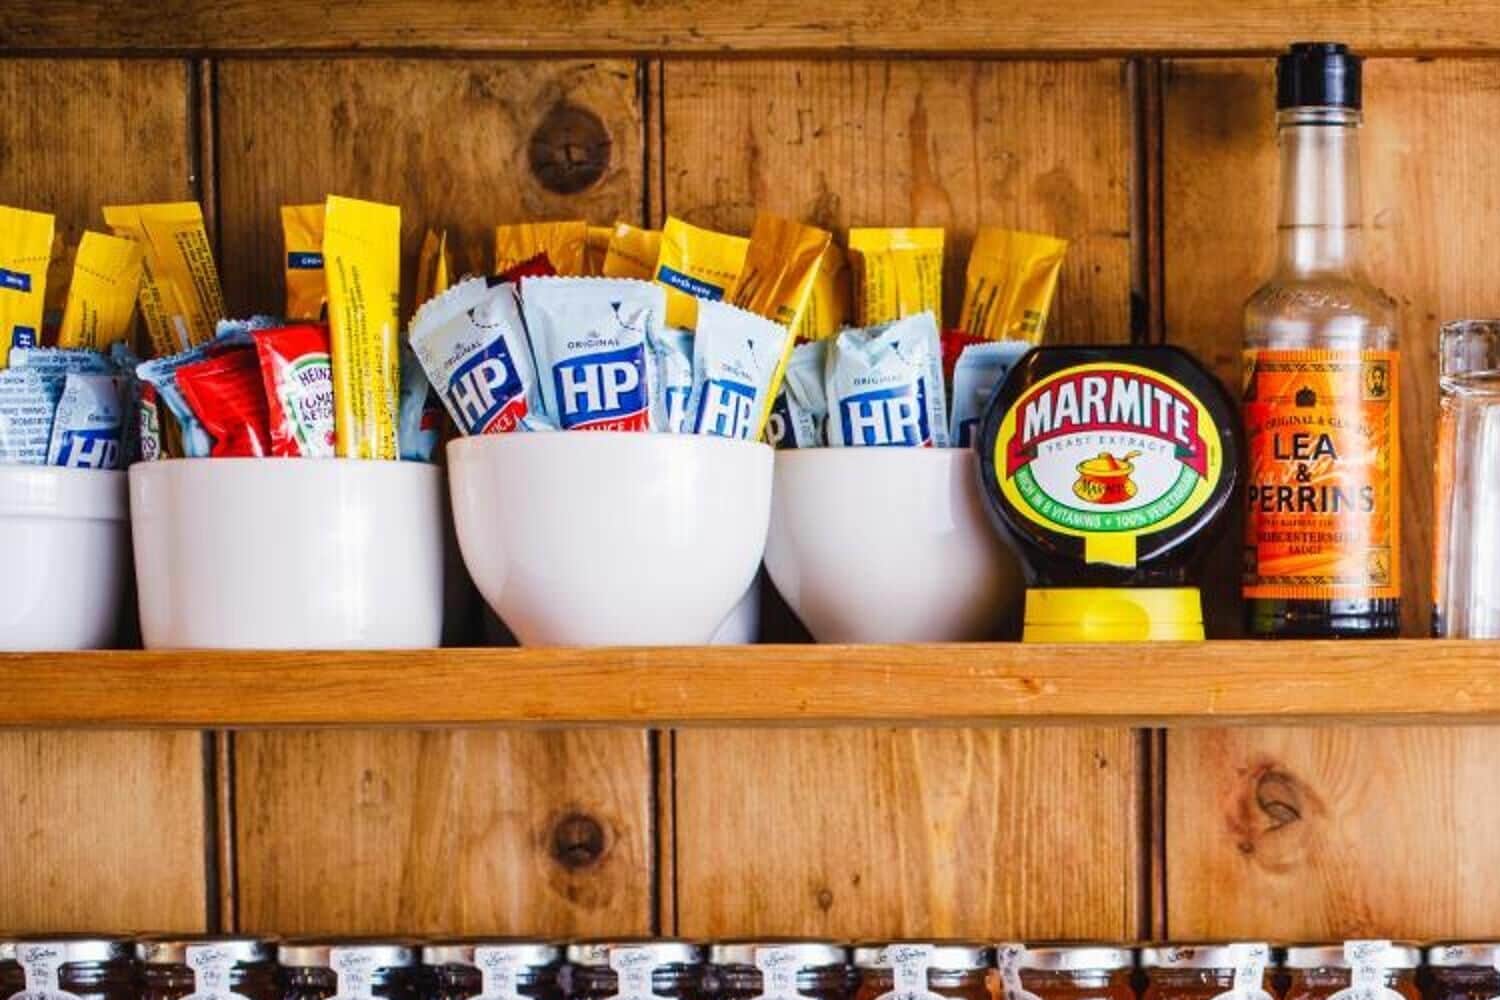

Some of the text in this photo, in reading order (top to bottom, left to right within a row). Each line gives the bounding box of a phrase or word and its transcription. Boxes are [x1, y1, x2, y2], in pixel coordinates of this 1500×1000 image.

[567, 338, 621, 350] ORIGINAL
[452, 357, 509, 430] HP
[558, 359, 640, 415] HP
[1022, 376, 1190, 446] MARMITE
[1045, 434, 1168, 452] YEAST EXTRACT
[1273, 432, 1338, 461] LEA
[1295, 462, 1312, 484] &
[1247, 484, 1375, 513] PERRINS
